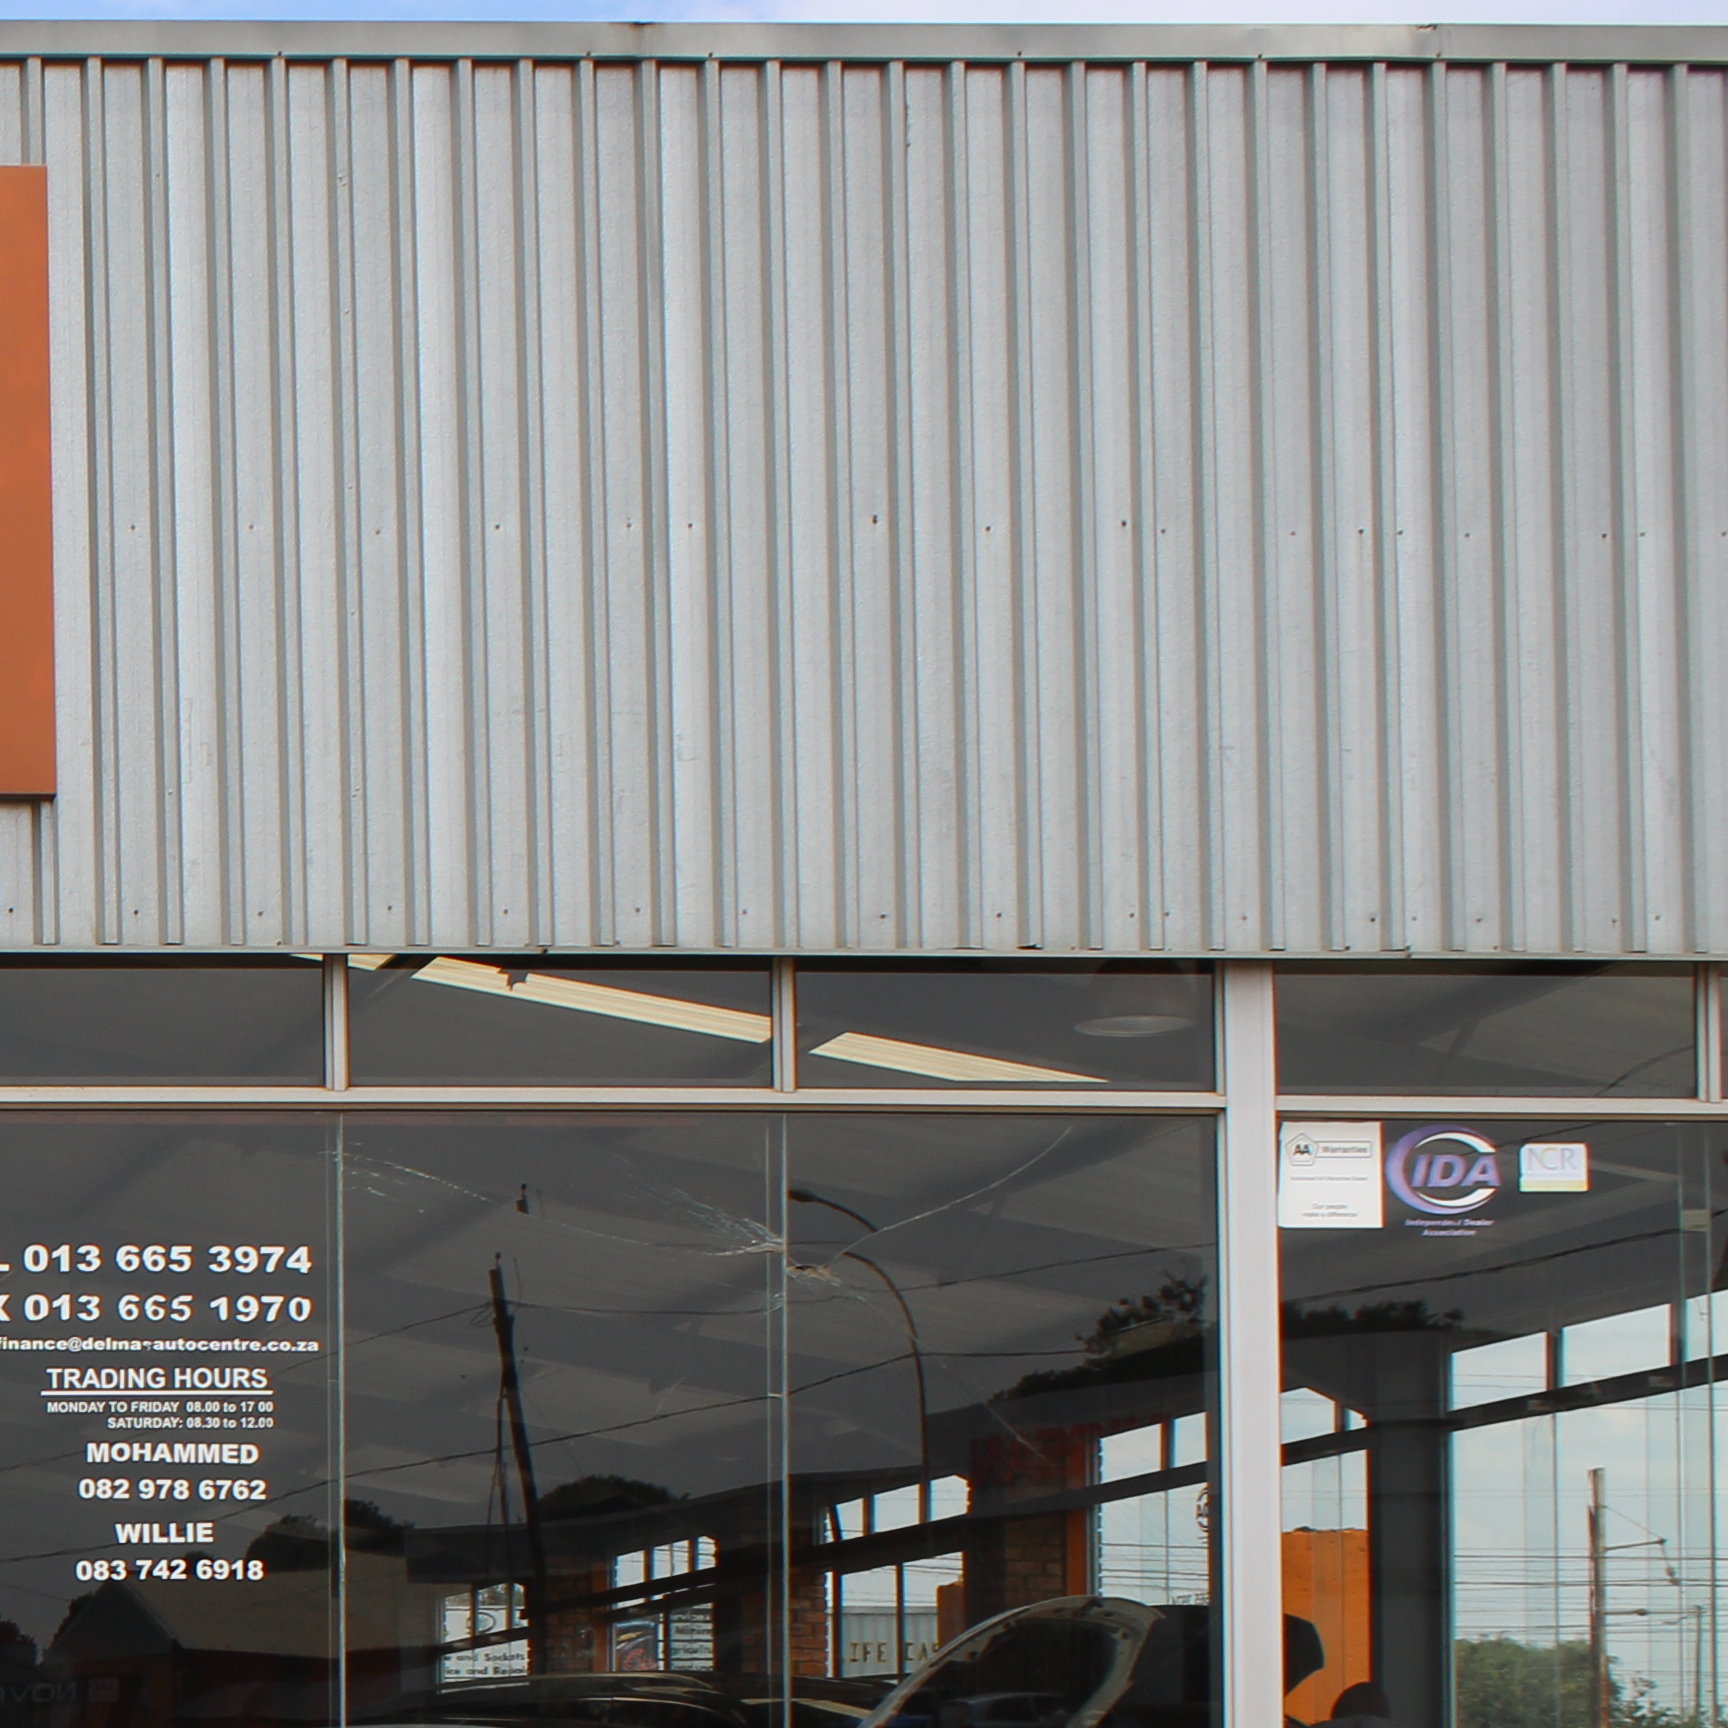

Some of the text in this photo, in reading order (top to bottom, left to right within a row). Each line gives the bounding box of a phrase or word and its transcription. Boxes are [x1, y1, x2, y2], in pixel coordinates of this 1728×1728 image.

[1292, 1143, 1312, 1156] AA
[1527, 1146, 1578, 1172] NCR
[1421, 1228, 1477, 1237] Association
[1463, 1218, 1496, 1227] Dealer
[23, 1244, 102, 1273] 013
[115, 1244, 193, 1272] 665
[208, 1245, 312, 1274] 3974
[24, 1294, 101, 1322] 013
[118, 1294, 193, 1322] 665
[209, 1295, 312, 1322] 1970
[45, 1367, 268, 1390] TRADING HOURS
[46, 1401, 106, 1414] MONDAY
[108, 1401, 128, 1413] TO
[130, 1401, 180, 1413] FRIDAY
[185, 1401, 221, 1413] 08.00
[222, 1401, 237, 1413] to
[107, 1416, 274, 1430] SATURDAY: 08.30 to 12.00
[86, 1442, 260, 1465] MOHAMMED
[78, 1478, 267, 1501] 082 978 6762
[114, 1522, 214, 1544] WILLIE
[76, 1559, 264, 1581] 083 742 6918
